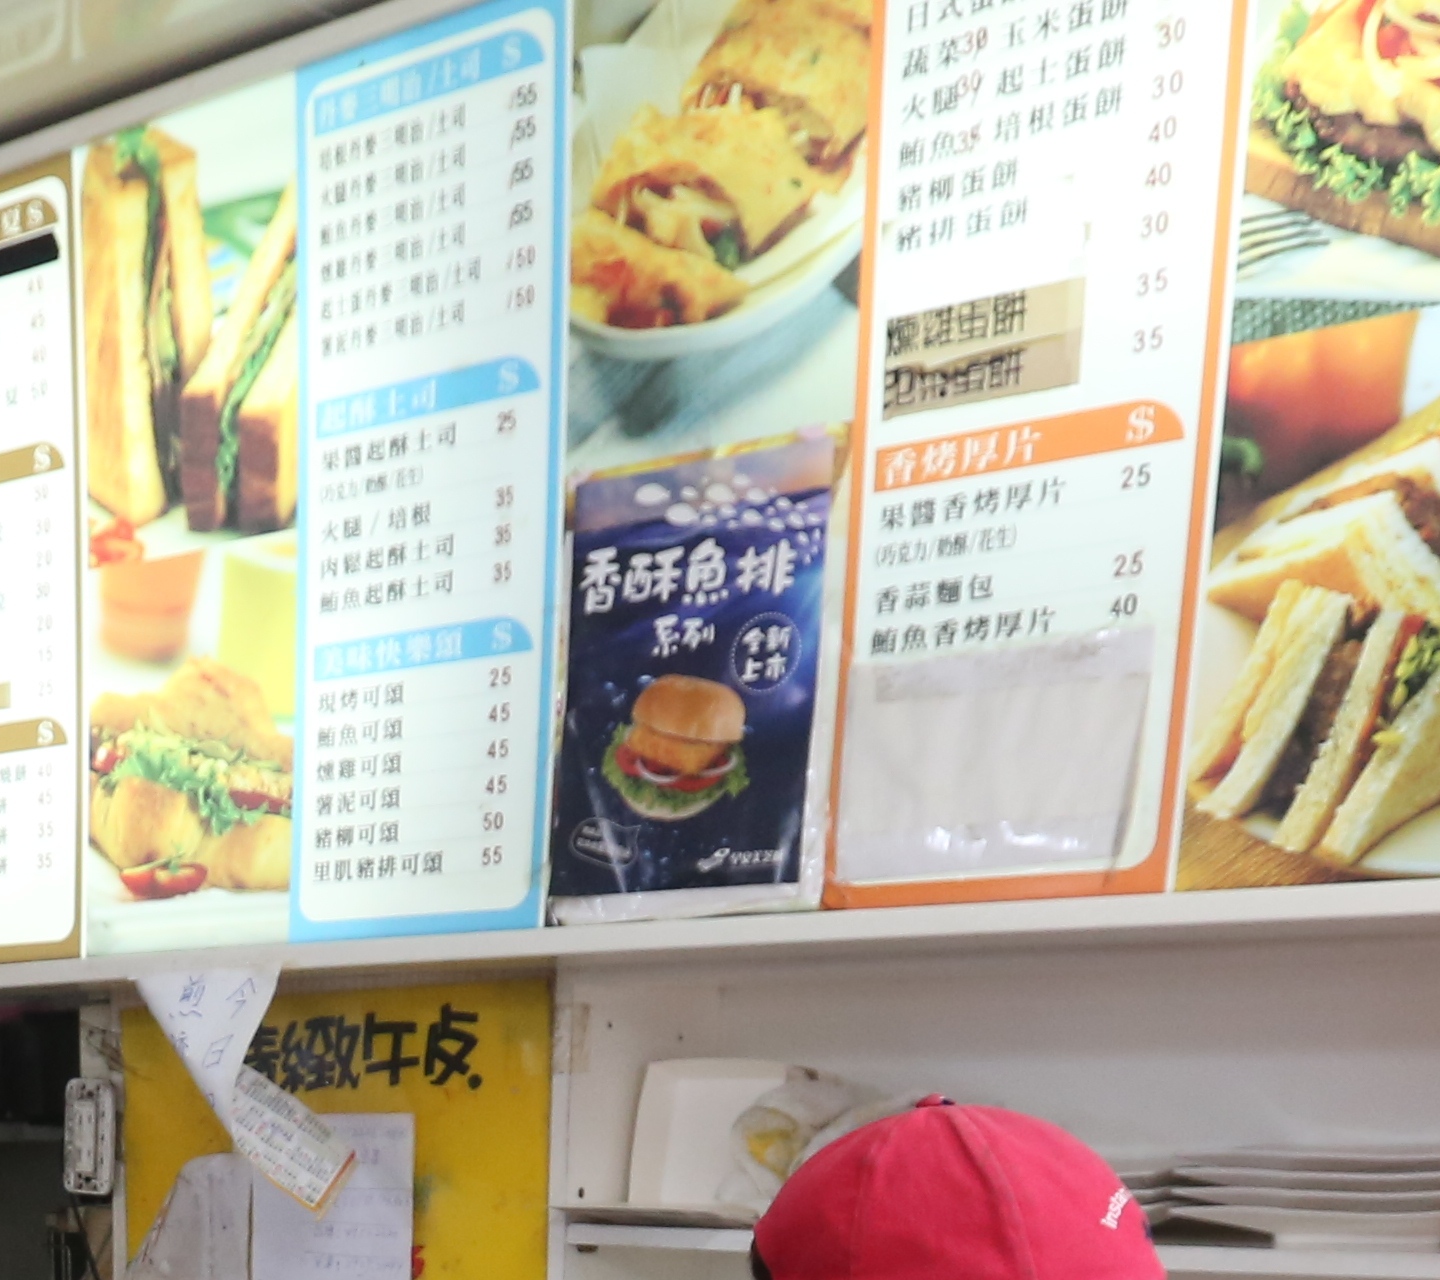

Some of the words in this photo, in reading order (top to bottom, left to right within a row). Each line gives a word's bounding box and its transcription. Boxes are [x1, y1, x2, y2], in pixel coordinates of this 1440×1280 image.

[998, 36, 1128, 94] 起士蛋餅
[1158, 18, 1186, 48] 30
[995, 86, 1122, 141] 培根蛋餅
[1152, 71, 1184, 99] 30
[898, 157, 1018, 212] 豬柳蛋餅
[1149, 115, 1177, 144] 40
[897, 198, 1029, 253] 豬排蛋餅
[1145, 162, 1172, 188] 40
[1141, 212, 1169, 239] 30
[1137, 267, 1168, 297] 35
[1134, 325, 1164, 354] 35
[497, 410, 516, 435] 25
[884, 427, 1041, 488] 香烤厚片
[495, 485, 514, 508] 35
[881, 475, 1066, 532] 果醬香烤厚片
[1121, 463, 1151, 489] 25
[494, 523, 512, 547] 35
[493, 561, 512, 584] 35
[580, 537, 796, 615] 香酥魚排
[1114, 550, 1144, 578] 25
[870, 606, 1056, 656] 鮪魚香烤厚片
[1110, 593, 1138, 617] 40
[489, 666, 512, 687] 25
[488, 702, 510, 722] 45
[487, 739, 509, 758] 45
[486, 775, 507, 794] 45
[483, 812, 503, 830] 50
[482, 846, 502, 866] 55
